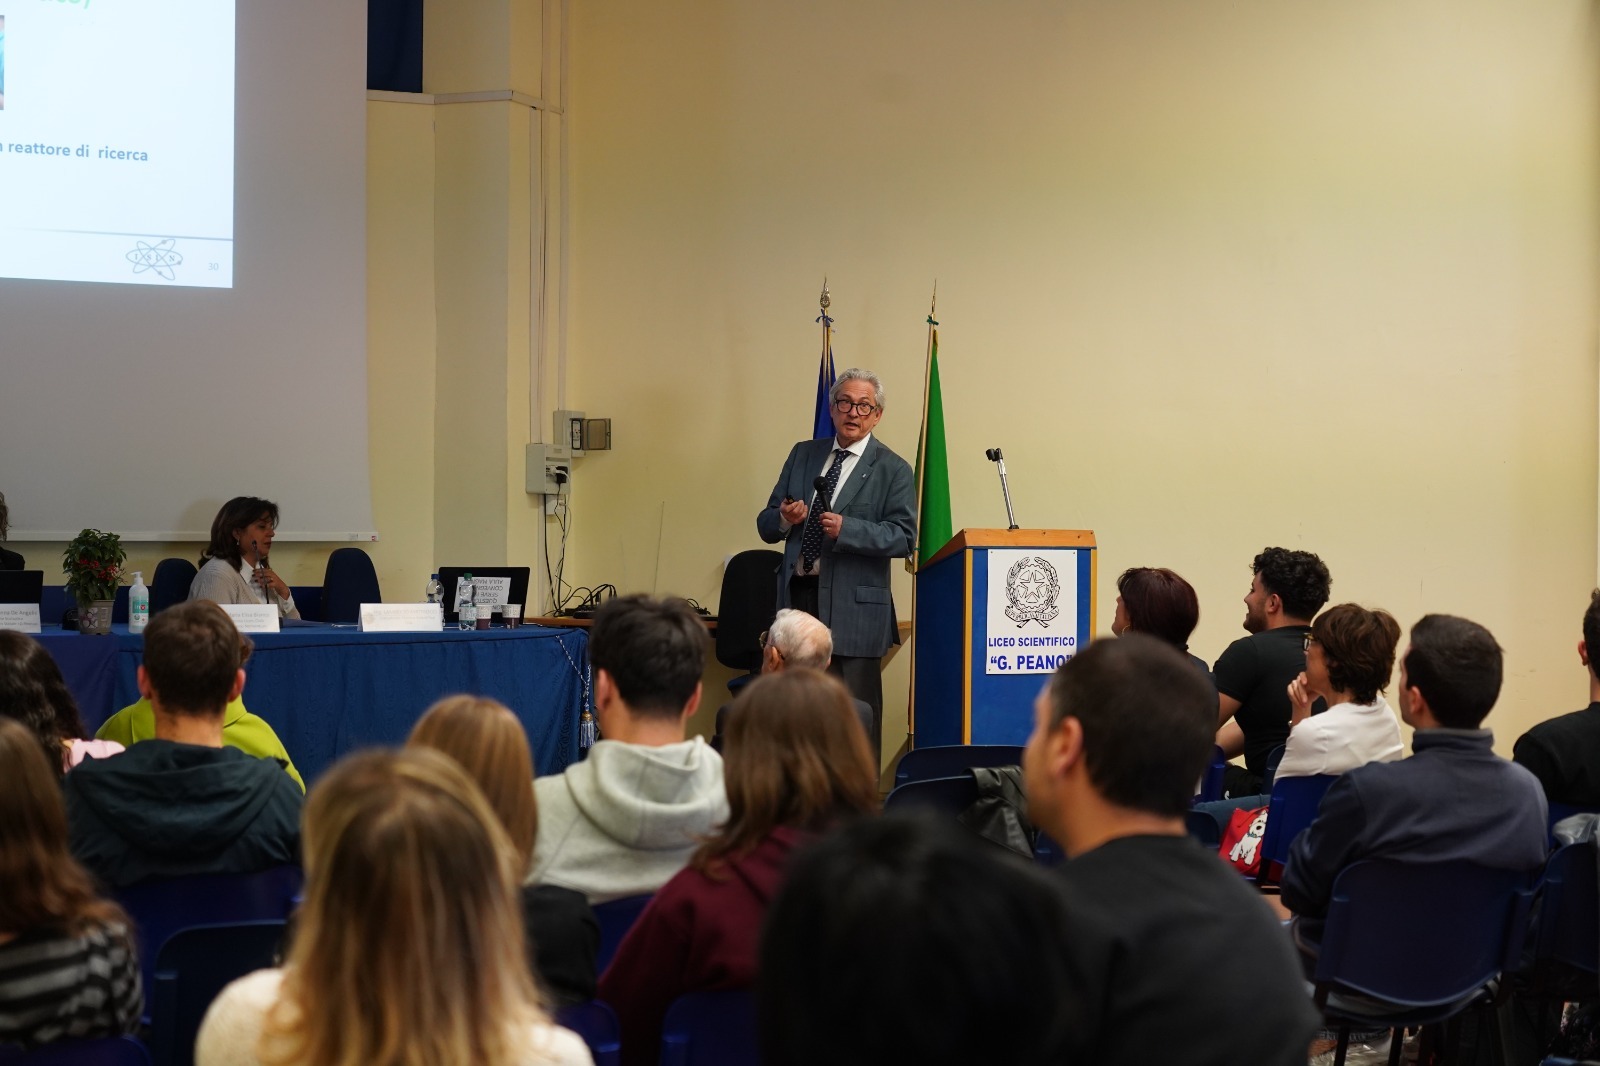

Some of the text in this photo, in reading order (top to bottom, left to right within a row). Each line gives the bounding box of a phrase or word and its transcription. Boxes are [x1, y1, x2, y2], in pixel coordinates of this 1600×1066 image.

[8, 142, 71, 157] reattore
[75, 144, 90, 158] di
[98, 146, 148, 161] ricerca
[207, 262, 220, 271] 30
[988, 636, 1074, 647] LICEO SCIENTIFICO
